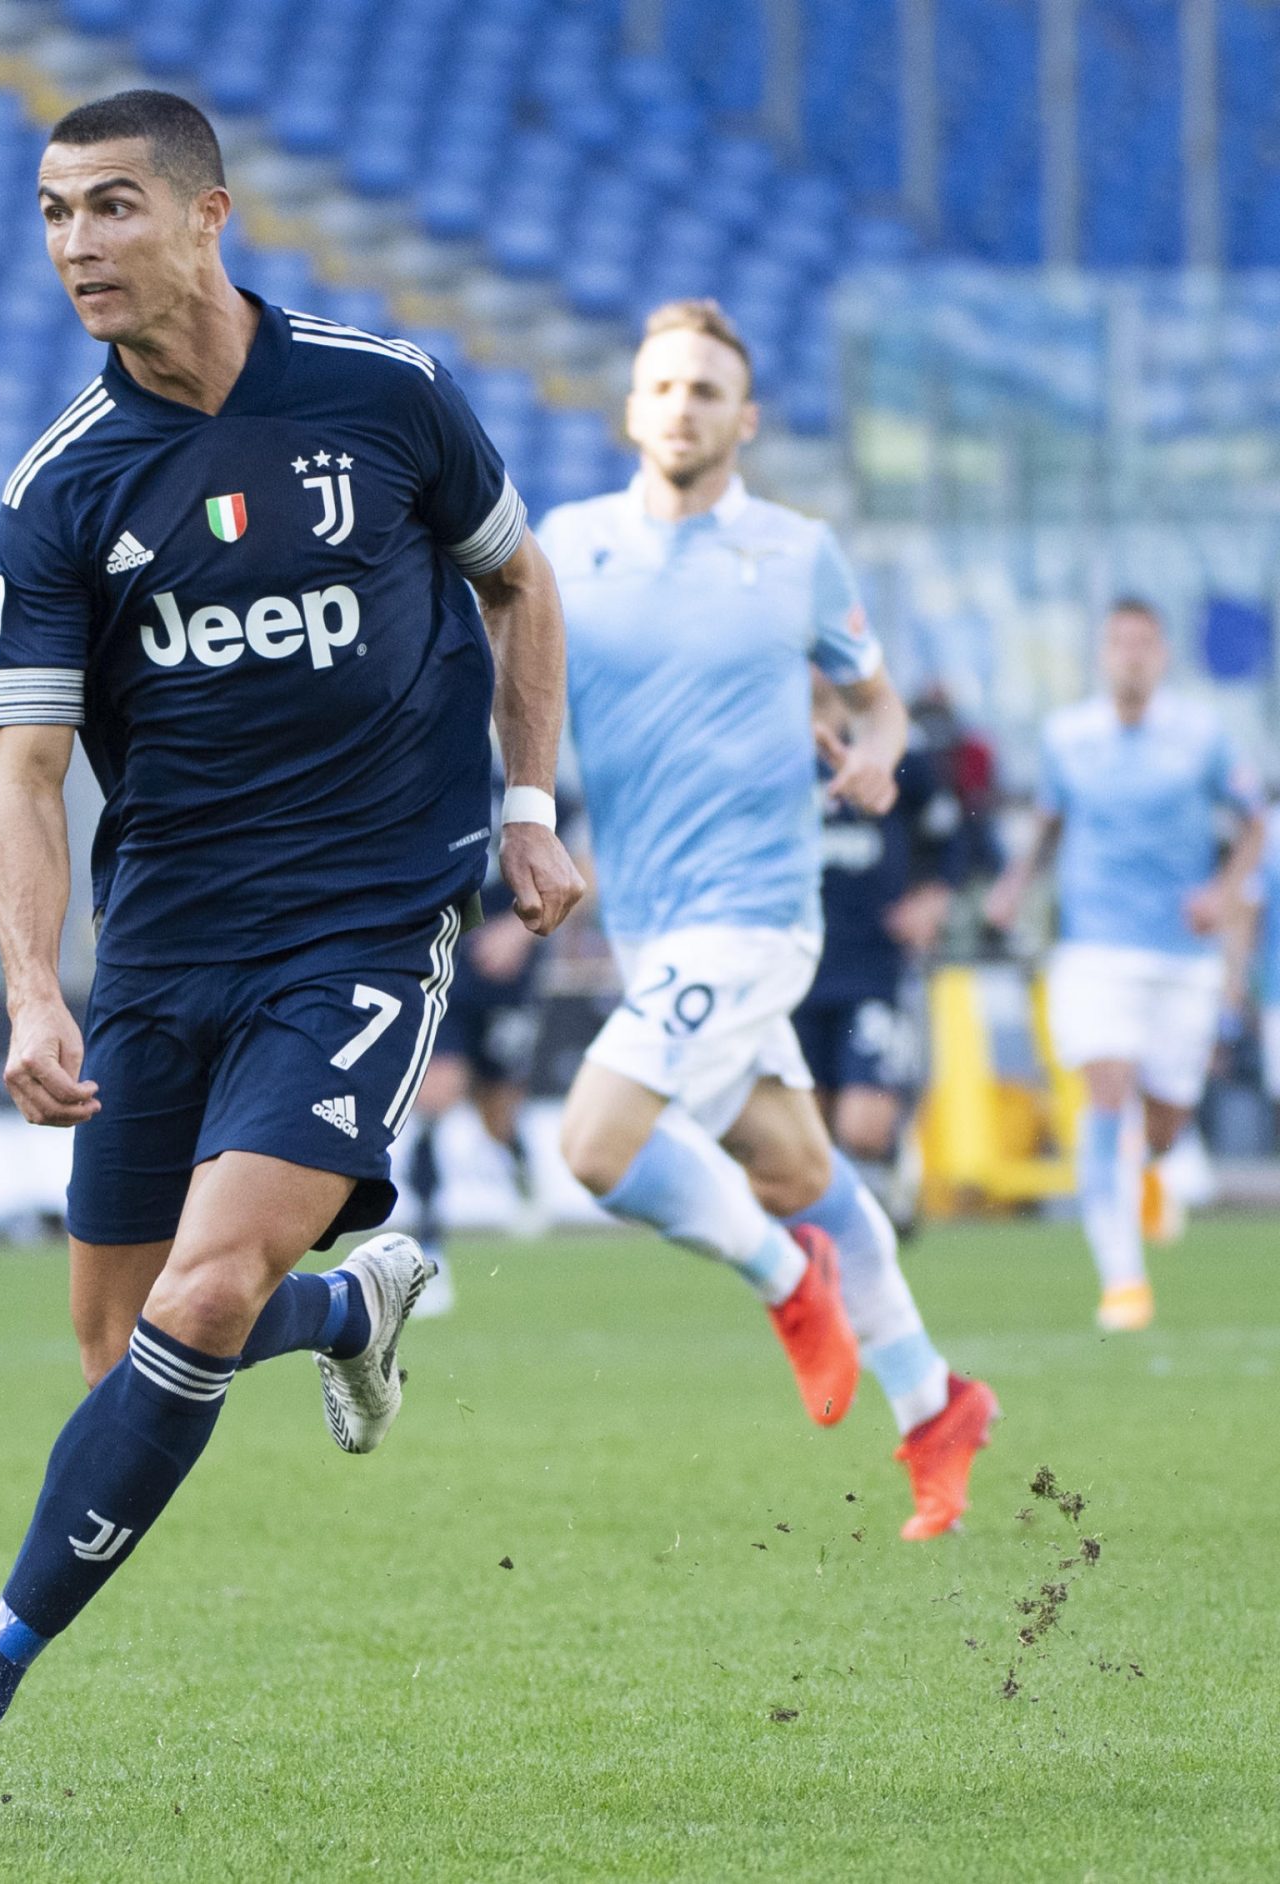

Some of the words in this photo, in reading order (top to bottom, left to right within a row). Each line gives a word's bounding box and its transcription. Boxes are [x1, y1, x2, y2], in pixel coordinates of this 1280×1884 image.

[106, 550, 155, 575] adidas
[140, 584, 361, 670] Jeep
[330, 983, 403, 1071] 7
[622, 964, 715, 1037] 29
[311, 1103, 359, 1139] adidas
